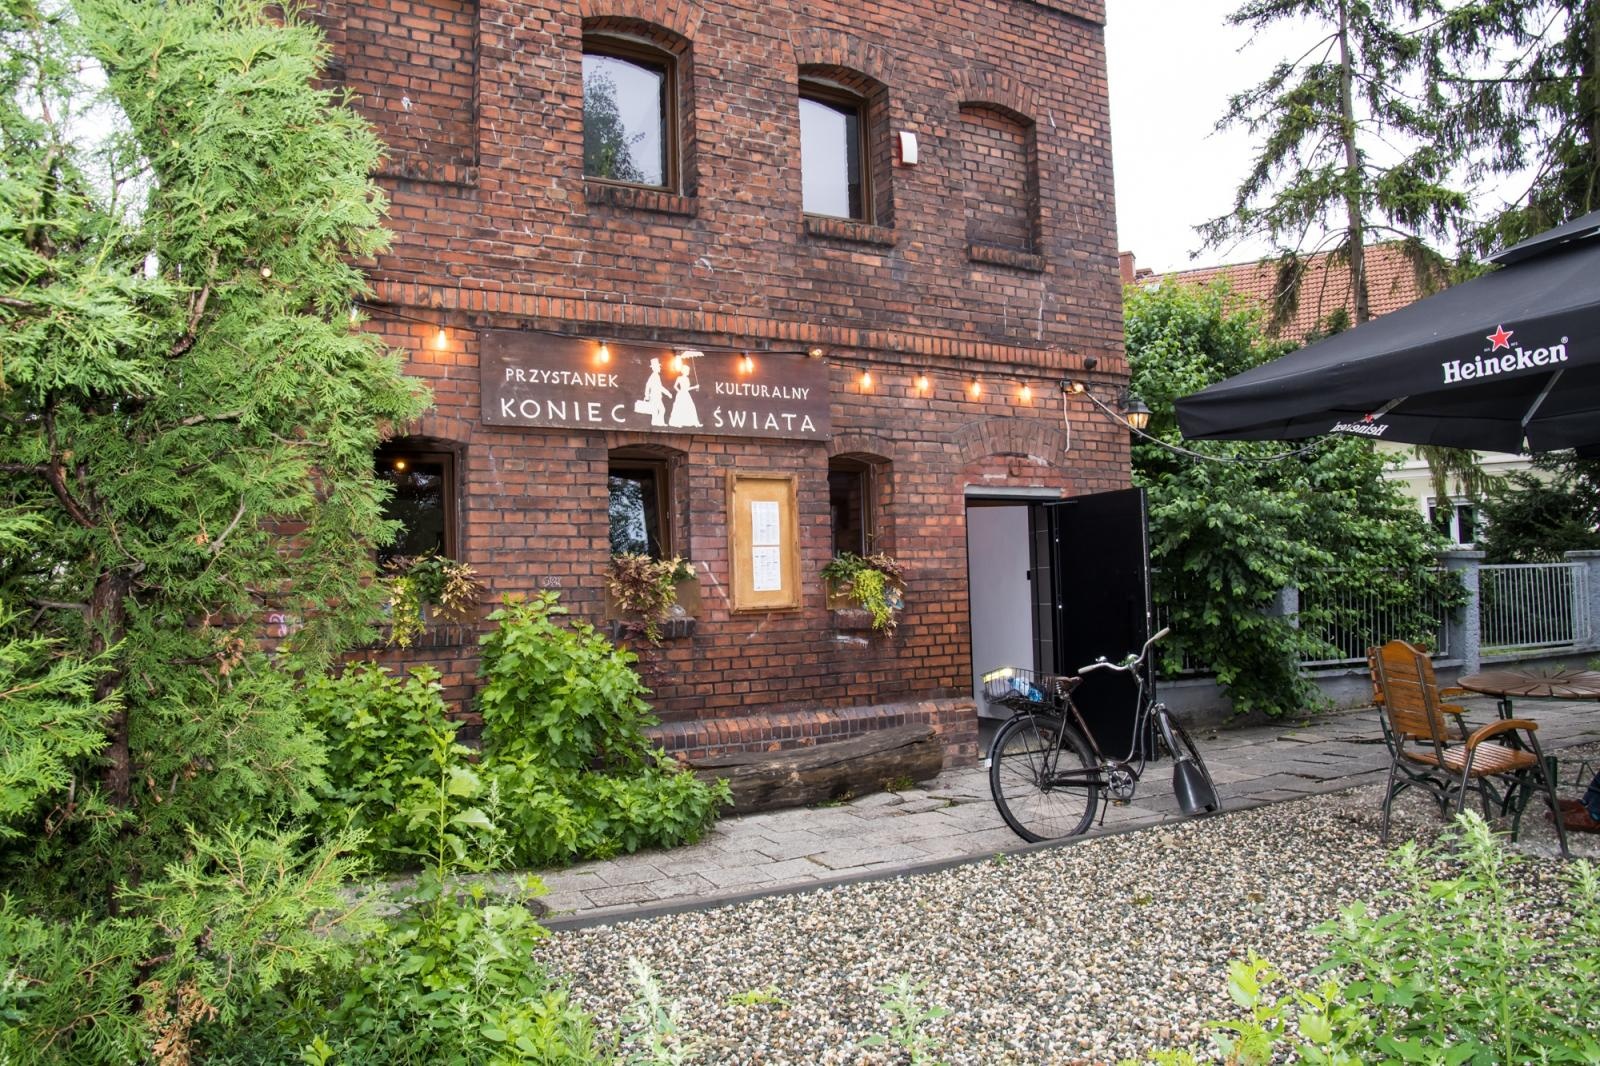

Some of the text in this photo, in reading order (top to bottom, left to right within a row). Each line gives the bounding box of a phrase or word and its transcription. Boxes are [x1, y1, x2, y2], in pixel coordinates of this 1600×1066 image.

[505, 367, 810, 401] PRZYSTANEK KULTURALNY
[500, 397, 817, 433] KONIEC ŚWIATA
